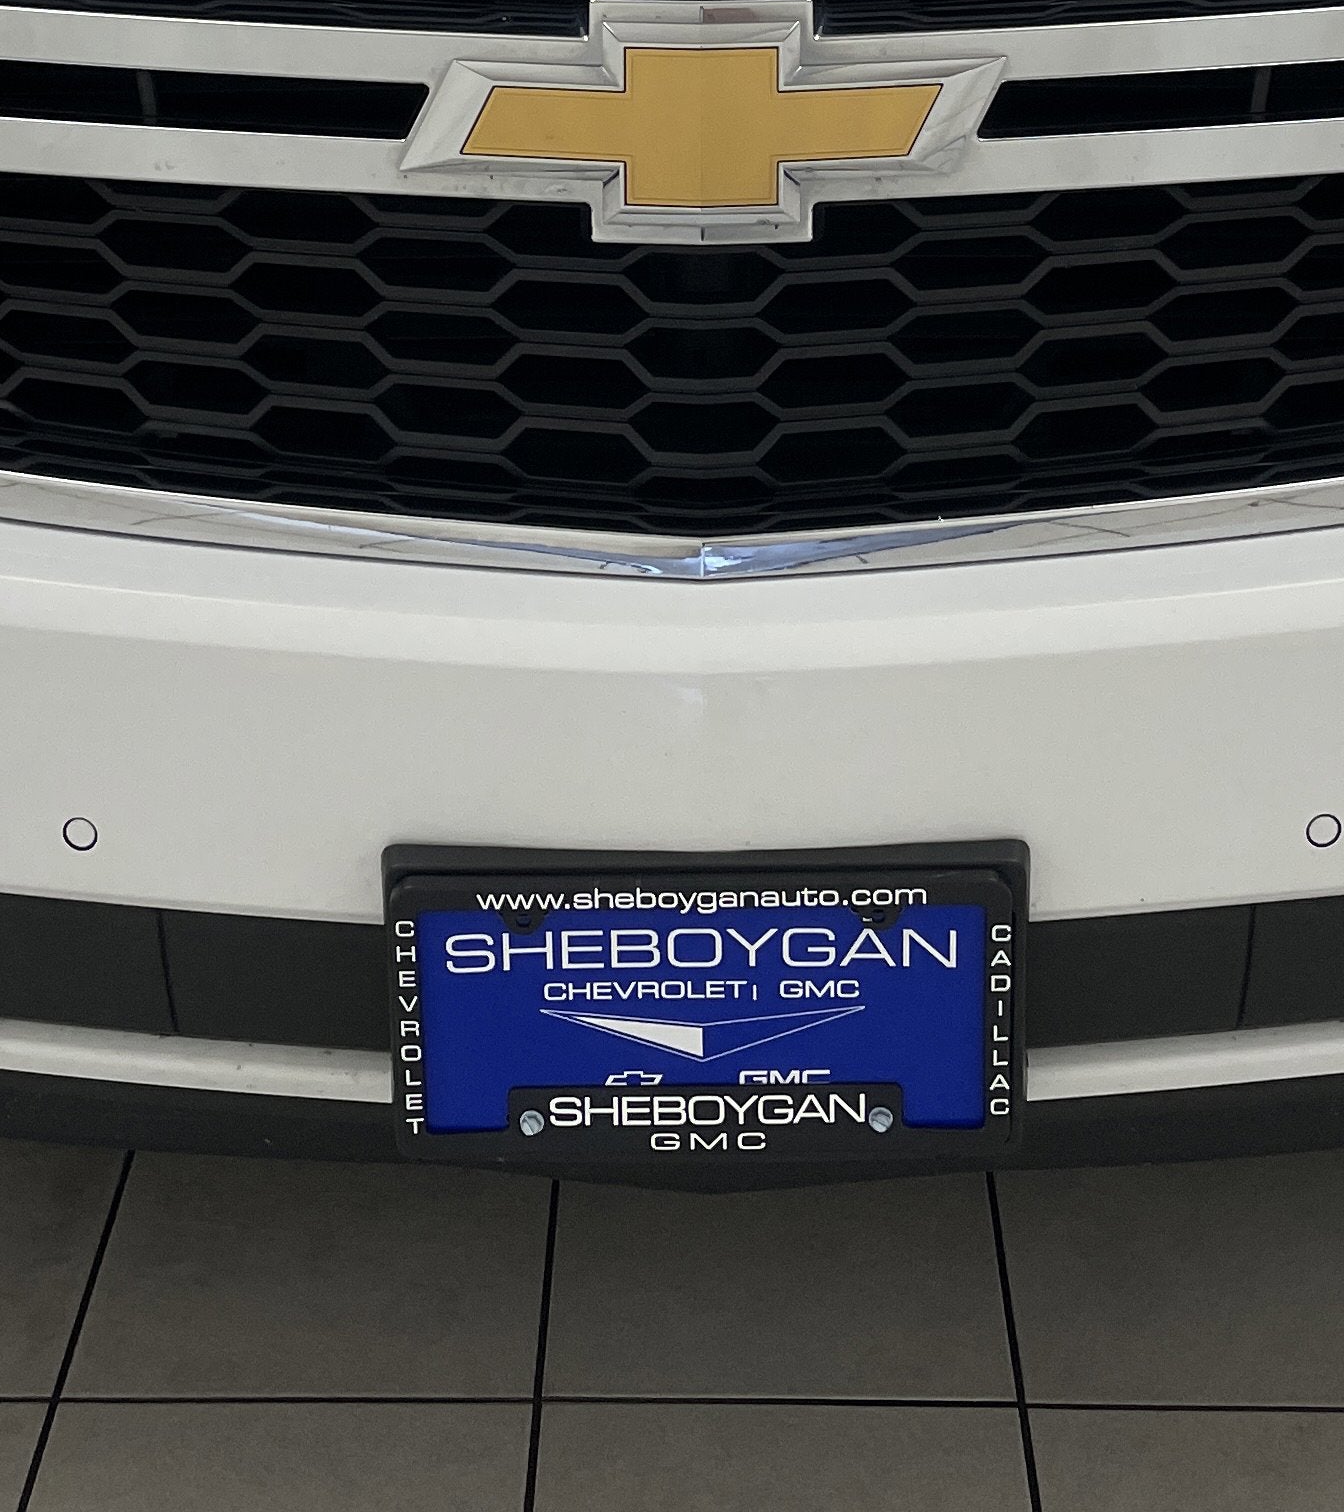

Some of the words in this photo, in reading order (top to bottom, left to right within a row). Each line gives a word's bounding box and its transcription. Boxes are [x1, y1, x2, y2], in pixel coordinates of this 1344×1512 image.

[476, 887, 927, 915] www.sheboyganauto.com
[445, 927, 957, 973] SHEBOYGAN
[543, 980, 748, 1001] CHEVROLET
[779, 979, 860, 999] GMC
[394, 920, 425, 1135] CHEVROLET
[989, 924, 1012, 1116] CADILLAC
[549, 1093, 867, 1127] SHEBOYGAN
[650, 1132, 767, 1151] GMC
